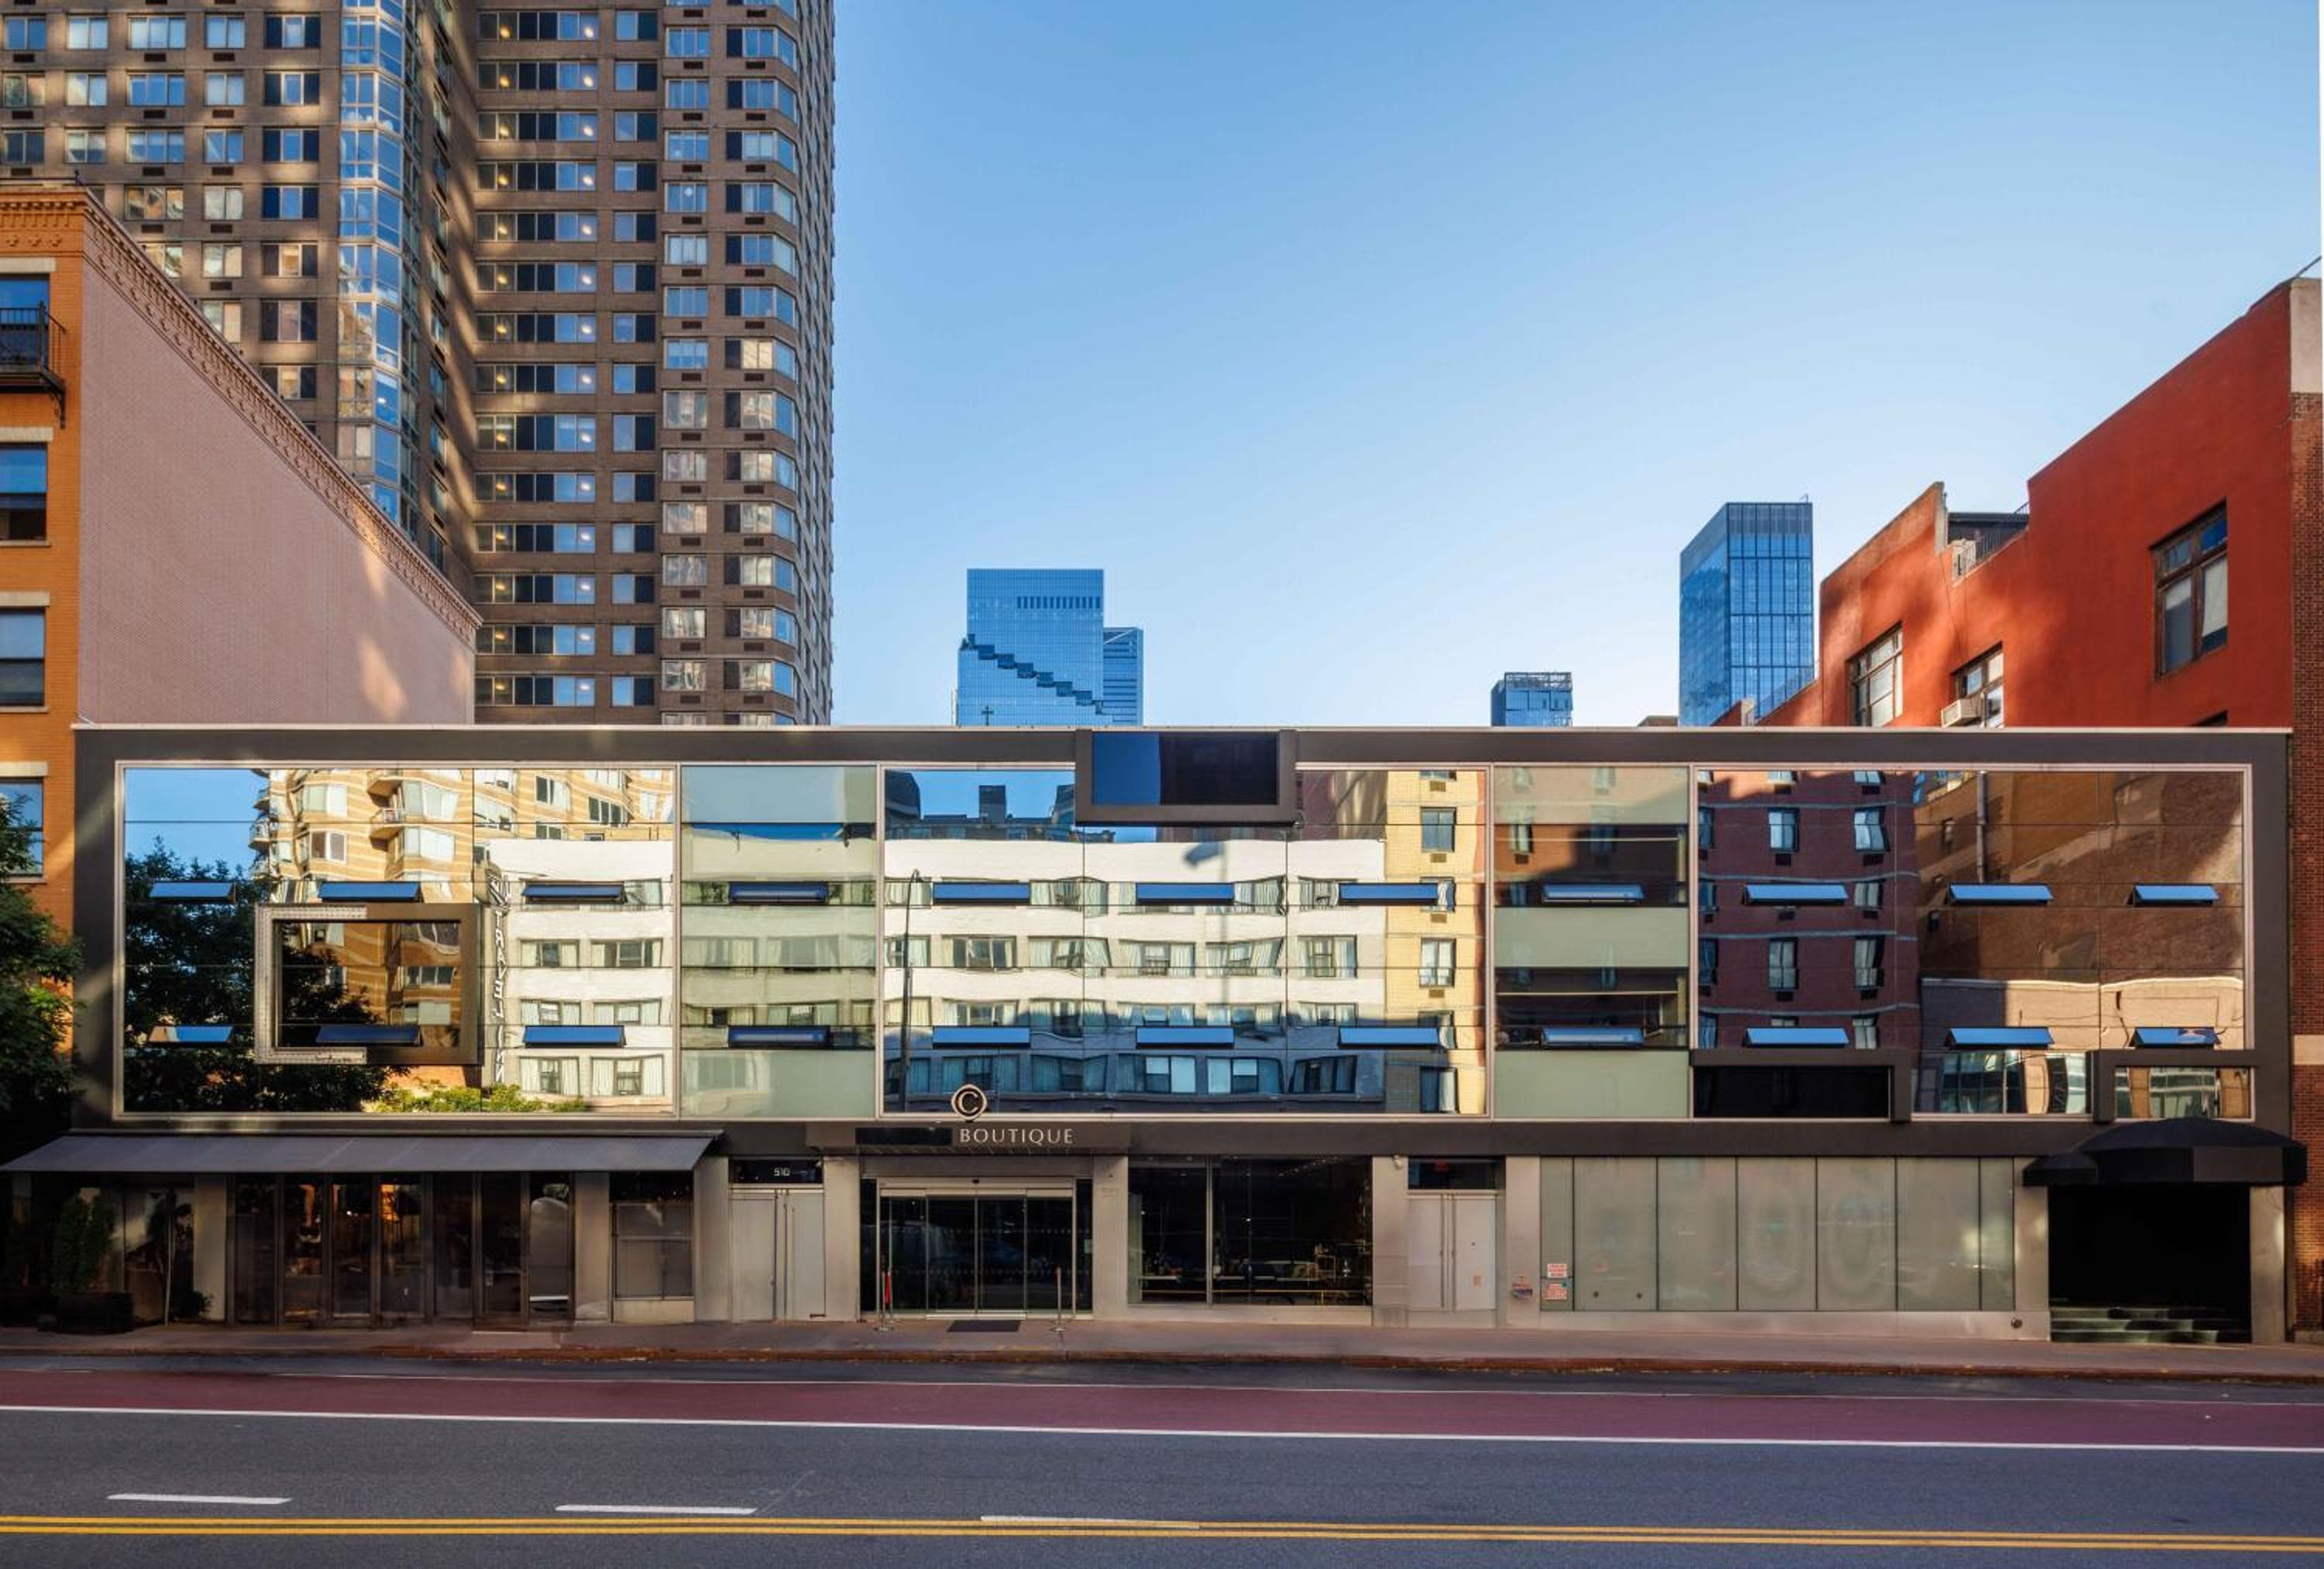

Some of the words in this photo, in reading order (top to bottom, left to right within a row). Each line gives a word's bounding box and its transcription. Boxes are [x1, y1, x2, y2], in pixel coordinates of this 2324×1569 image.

[957, 1091, 978, 1114] C
[959, 1128, 1074, 1145] BOUTIQUE
[774, 1167, 790, 1176] 510
